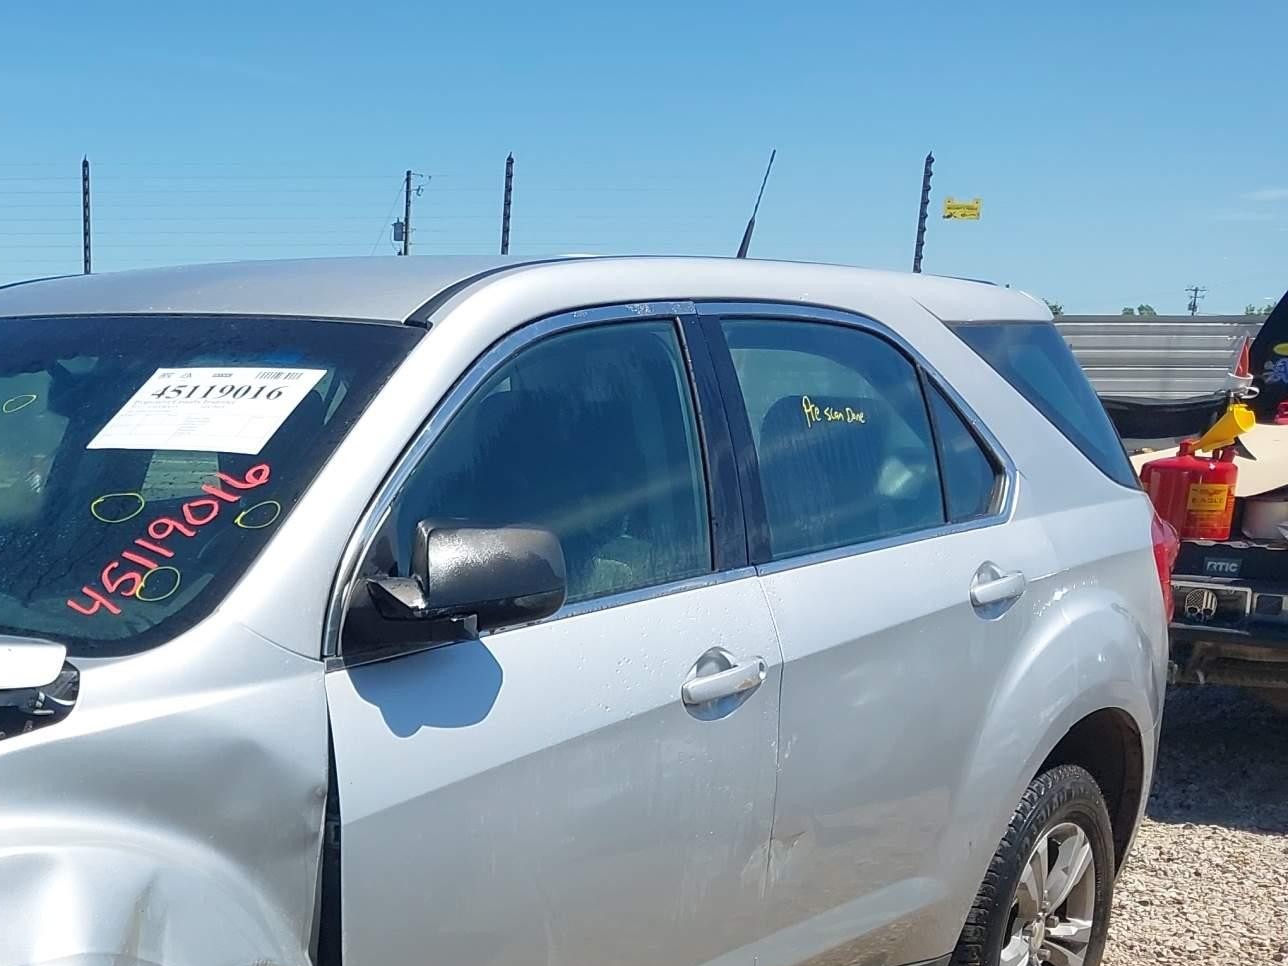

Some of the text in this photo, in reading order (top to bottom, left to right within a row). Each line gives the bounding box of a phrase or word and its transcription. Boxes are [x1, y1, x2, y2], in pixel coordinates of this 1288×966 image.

[151, 384, 288, 400] 45119016
[67, 464, 270, 615] 45119016
[1206, 561, 1239, 573] RTIC
